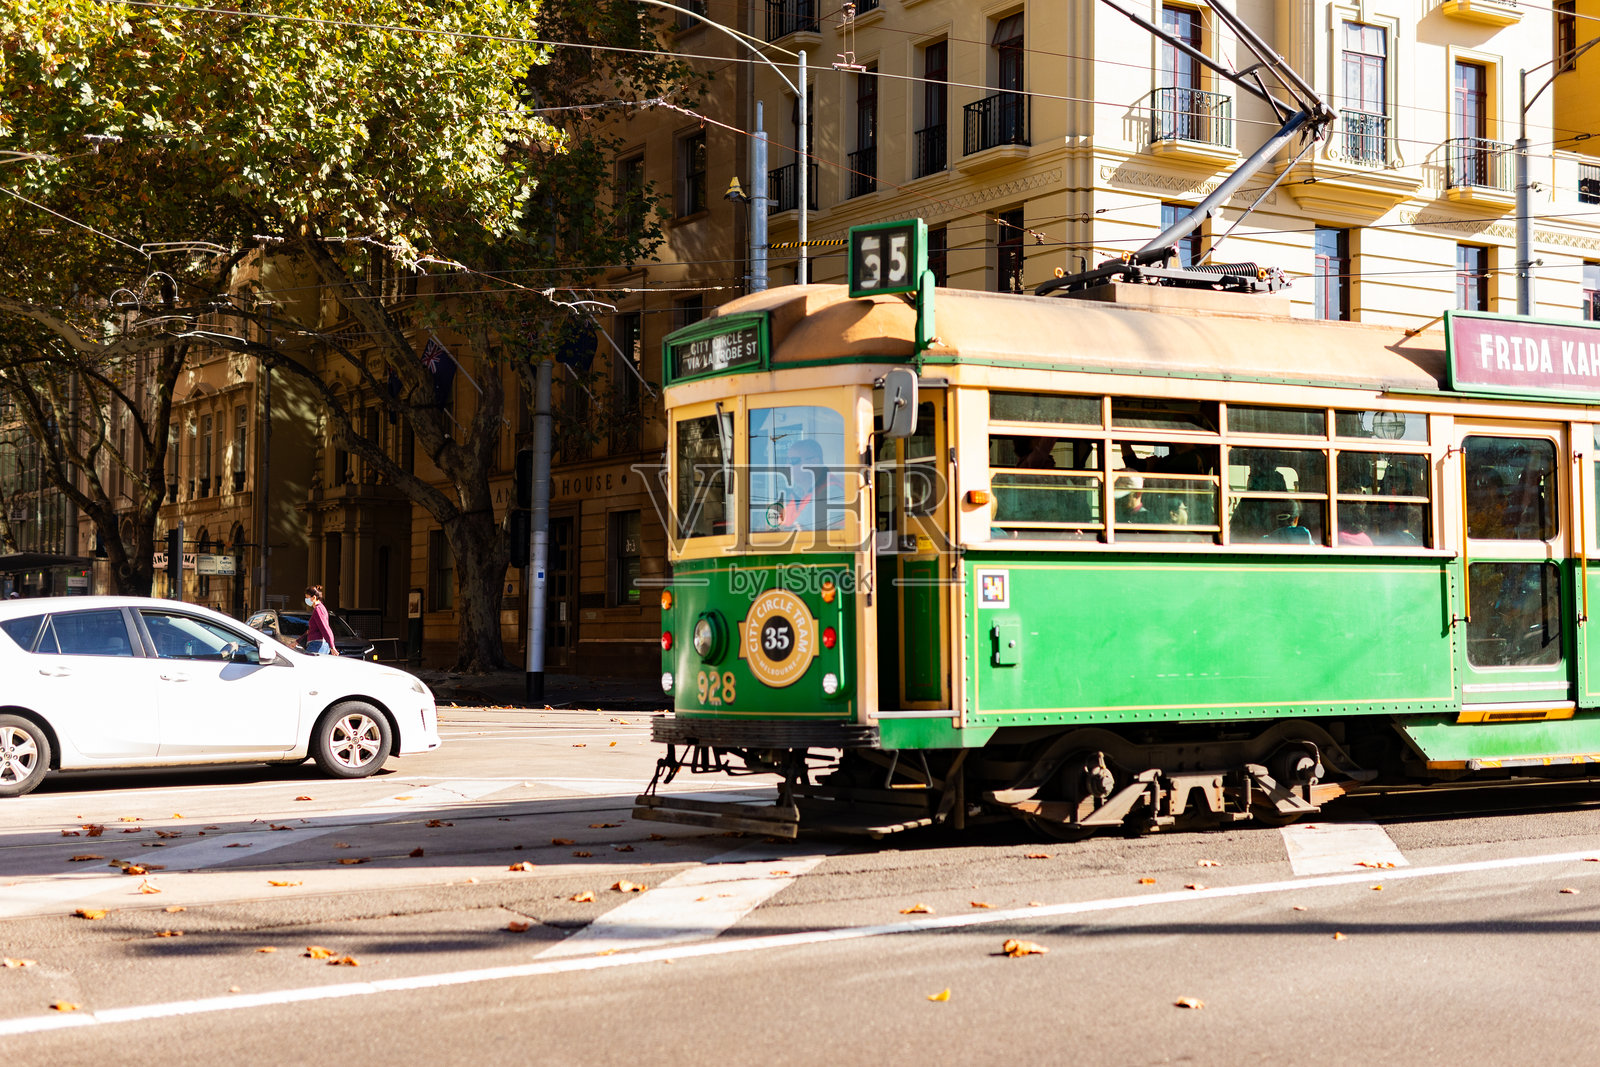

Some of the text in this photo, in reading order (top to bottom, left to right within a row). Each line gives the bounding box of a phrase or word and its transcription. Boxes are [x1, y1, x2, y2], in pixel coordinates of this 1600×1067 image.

[687, 357, 700, 370] VIA
[714, 345, 743, 363] TROBE
[746, 341, 757, 355] ST
[690, 339, 710, 356] CITY
[712, 331, 743, 350] CIRCLE
[1479, 333, 1554, 374] FRIDA
[562, 473, 613, 497] HOUSE
[749, 597, 809, 654] CITY CIRCLE TRAM
[764, 626, 790, 650] 35
[758, 660, 798, 677] MELBOURNE
[697, 671, 737, 706] 928
